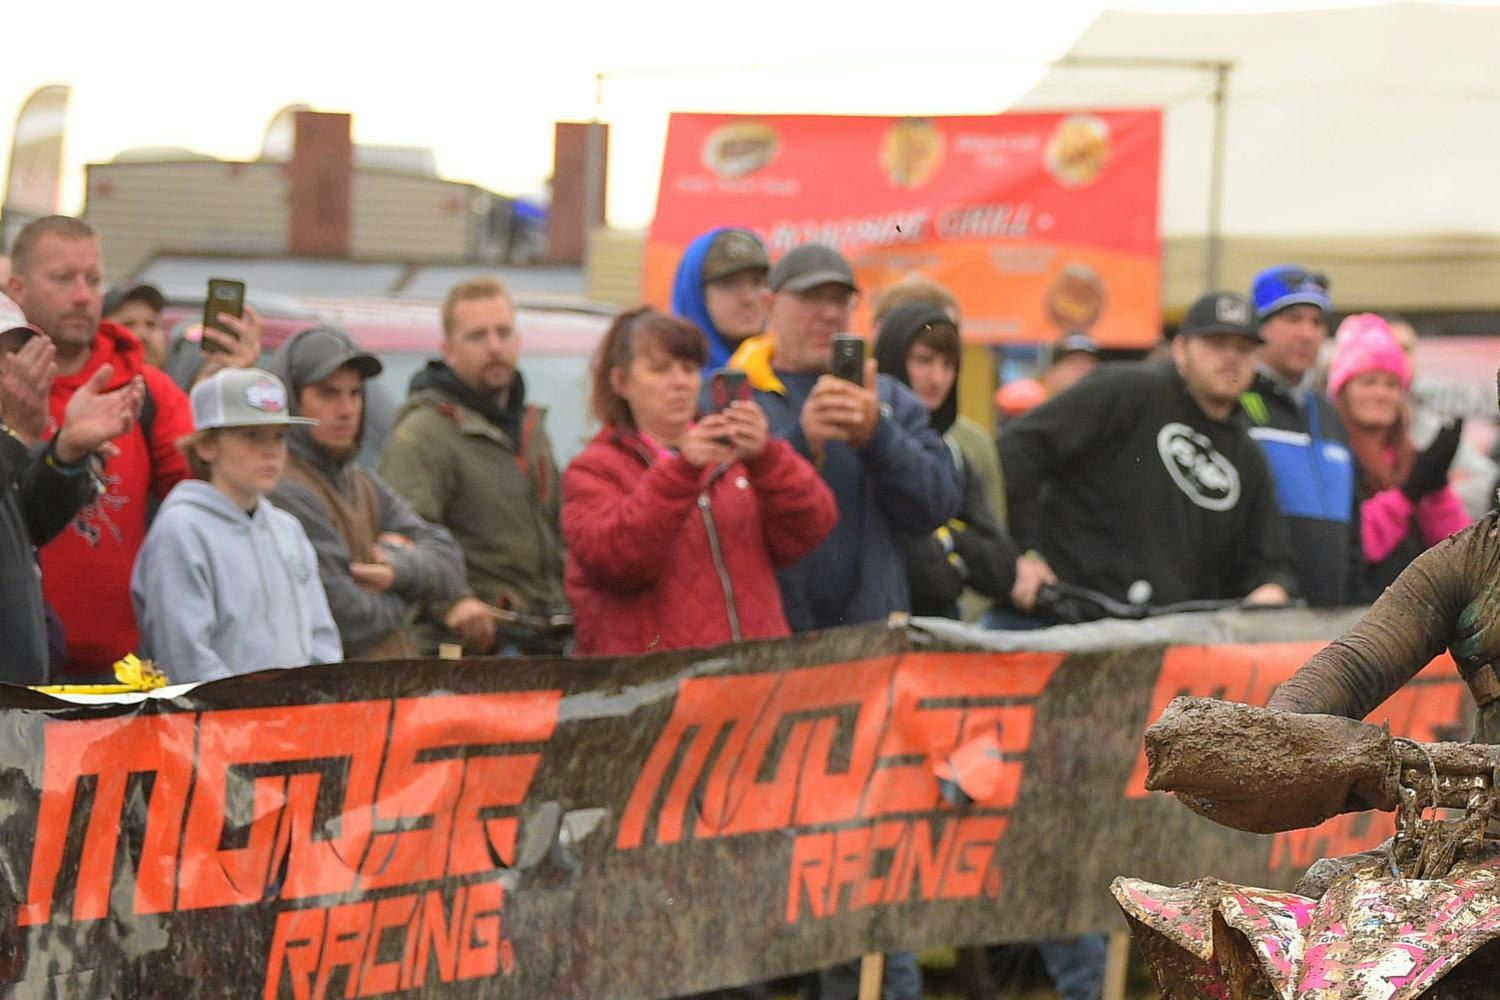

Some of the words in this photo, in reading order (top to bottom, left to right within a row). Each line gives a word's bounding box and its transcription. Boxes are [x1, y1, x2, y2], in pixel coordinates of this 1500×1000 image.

[17, 690, 562, 927] MOOSE
[616, 652, 1067, 849] MOOSE
[786, 816, 1008, 924] RACING
